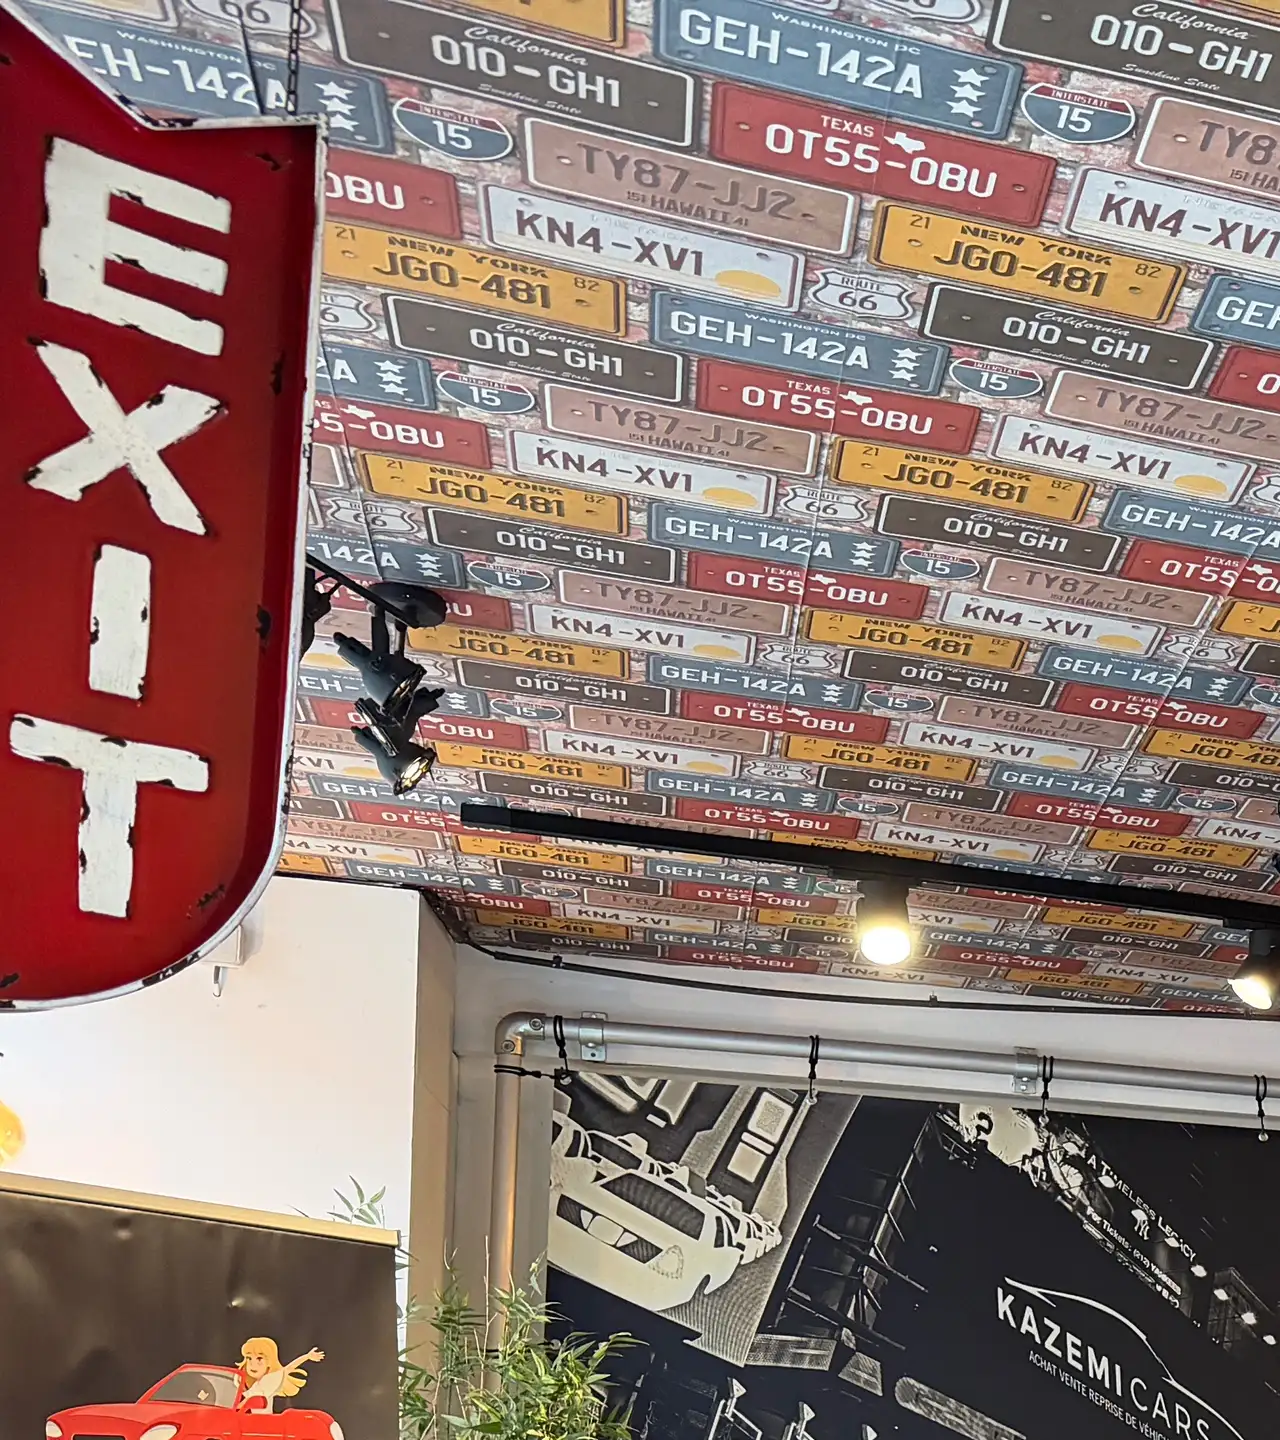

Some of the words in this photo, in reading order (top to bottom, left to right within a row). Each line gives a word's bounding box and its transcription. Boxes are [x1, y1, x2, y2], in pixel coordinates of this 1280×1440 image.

[680, 7, 924, 98] GEH-142A
[433, 120, 472, 150] 15
[822, 115, 876, 137] TEXAS
[470, 253, 548, 276] YORK
[670, 309, 870, 369] GEH-142A
[10, 135, 232, 919] EXIT
[351, 514, 387, 526] 66
[996, 1286, 1122, 1397] KAZEMI
[1029, 1350, 1057, 1376] ACHAT
[1058, 1367, 1087, 1397] VENTE
[1088, 1388, 1124, 1421] REPRISE
[1125, 1414, 1138, 1430] DE
